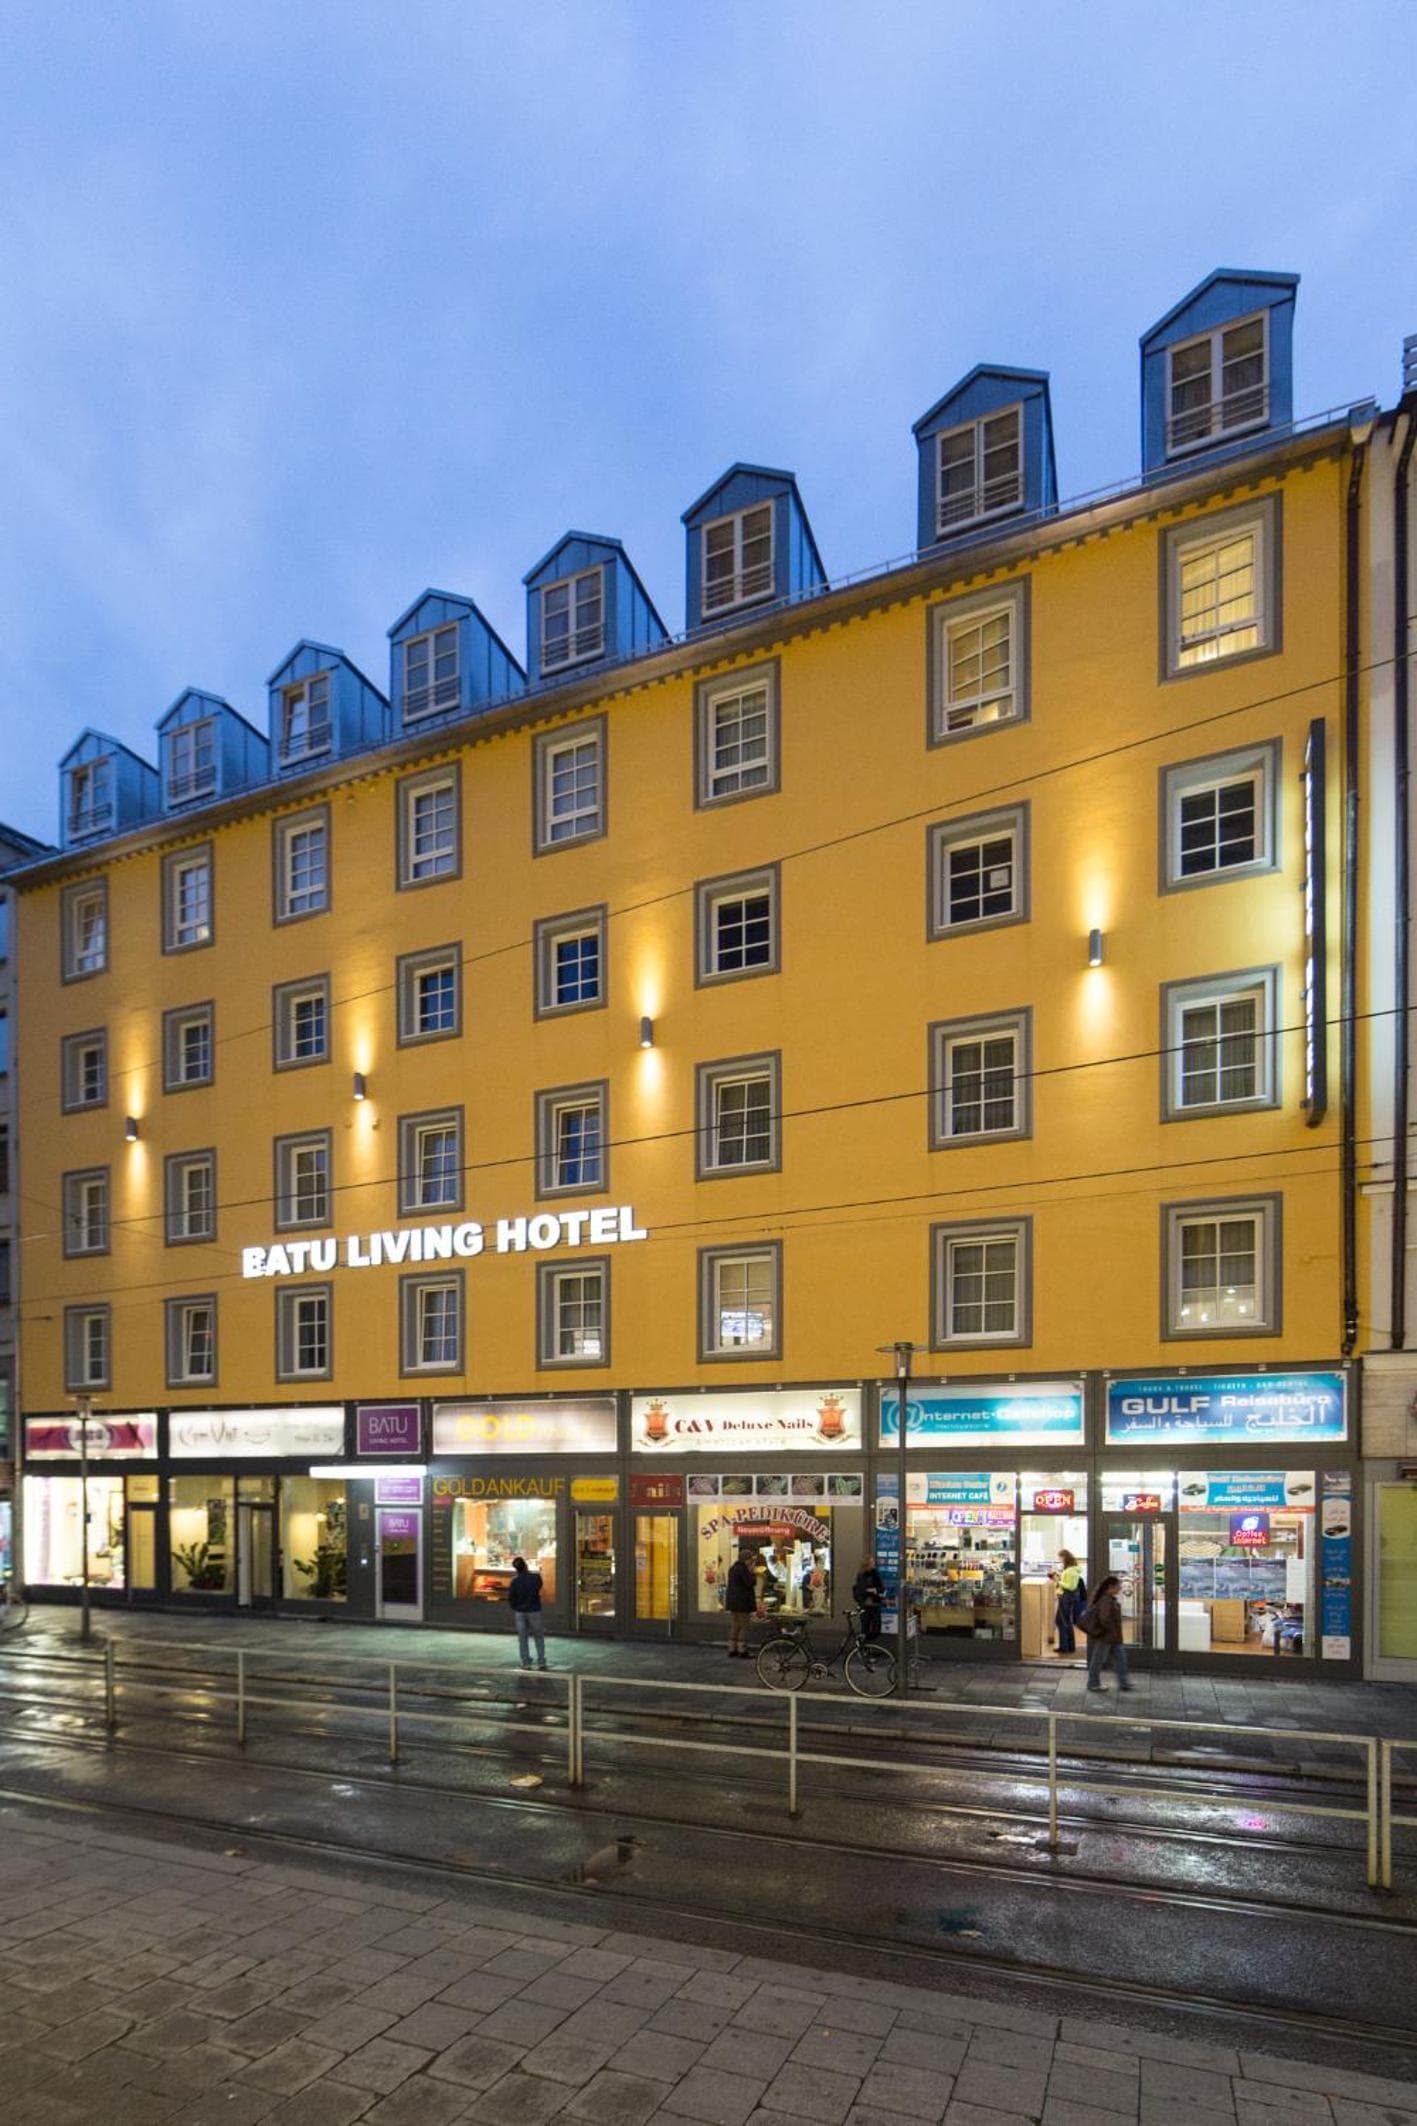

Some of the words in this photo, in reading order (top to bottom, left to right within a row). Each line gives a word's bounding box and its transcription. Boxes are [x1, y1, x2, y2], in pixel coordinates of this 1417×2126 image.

[242, 1238, 337, 1279] BATU
[347, 1221, 484, 1269] LIVING
[496, 1205, 648, 1254] HOTEL
[1122, 1396, 1210, 1415] GULF
[369, 1416, 409, 1434] BATU
[455, 1413, 535, 1442] GOLD
[722, 1420, 774, 1431] Deluxe
[776, 1418, 814, 1430] Nails
[432, 1476, 566, 1496] GOLDANKAUF
[1035, 1493, 1072, 1505] OPEN
